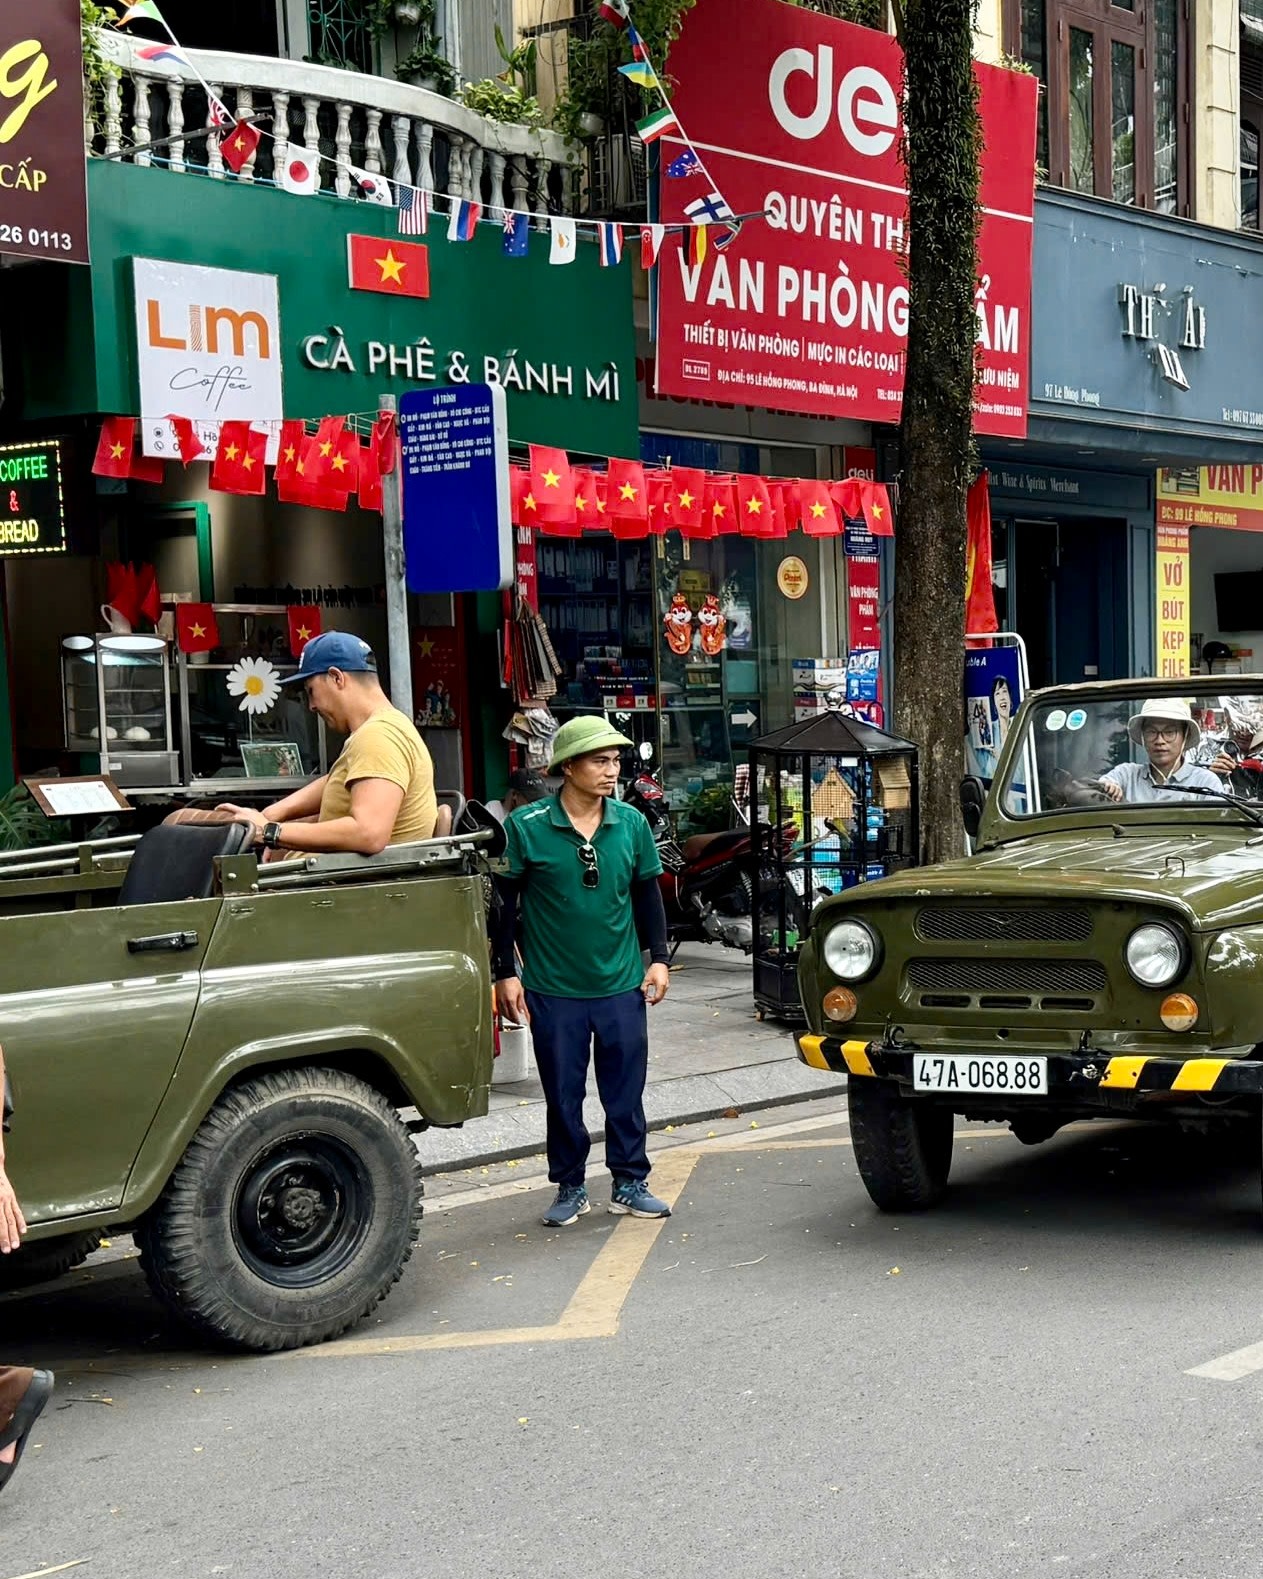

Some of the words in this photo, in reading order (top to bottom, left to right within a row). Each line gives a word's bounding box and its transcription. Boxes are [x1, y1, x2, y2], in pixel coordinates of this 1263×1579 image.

[764, 190, 863, 244] QUYÊN
[28, 228, 72, 250] 0113
[778, 259, 910, 337] PHÒNG
[305, 326, 356, 372] CÀ
[368, 337, 437, 380] PHÊ
[448, 350, 471, 384] &
[484, 349, 573, 396] BÁNH
[585, 362, 620, 401] MÌ
[683, 318, 715, 346] THIẾT
[717, 328, 729, 353] BỊ
[731, 327, 756, 352] VĂN
[758, 332, 799, 358] PHÒNG
[807, 341, 833, 366] MỰC
[834, 345, 846, 365] IN
[848, 344, 873, 368] CÁC
[874, 352, 899, 377] LOẠI
[997, 367, 1020, 393] NIỆM
[169, 365, 252, 412] Coffee
[0, 455, 48, 482] COFFEE
[9, 490, 20, 512] &
[1174, 506, 1184, 521] 99
[1213, 511, 1238, 526] PHONG
[1163, 555, 1183, 586] VỞ
[1162, 596, 1185, 621] BÚT
[1162, 631, 1185, 655] KẸP
[1162, 658, 1185, 677] FILE
[919, 1058, 1041, 1089] 47A-068.88
